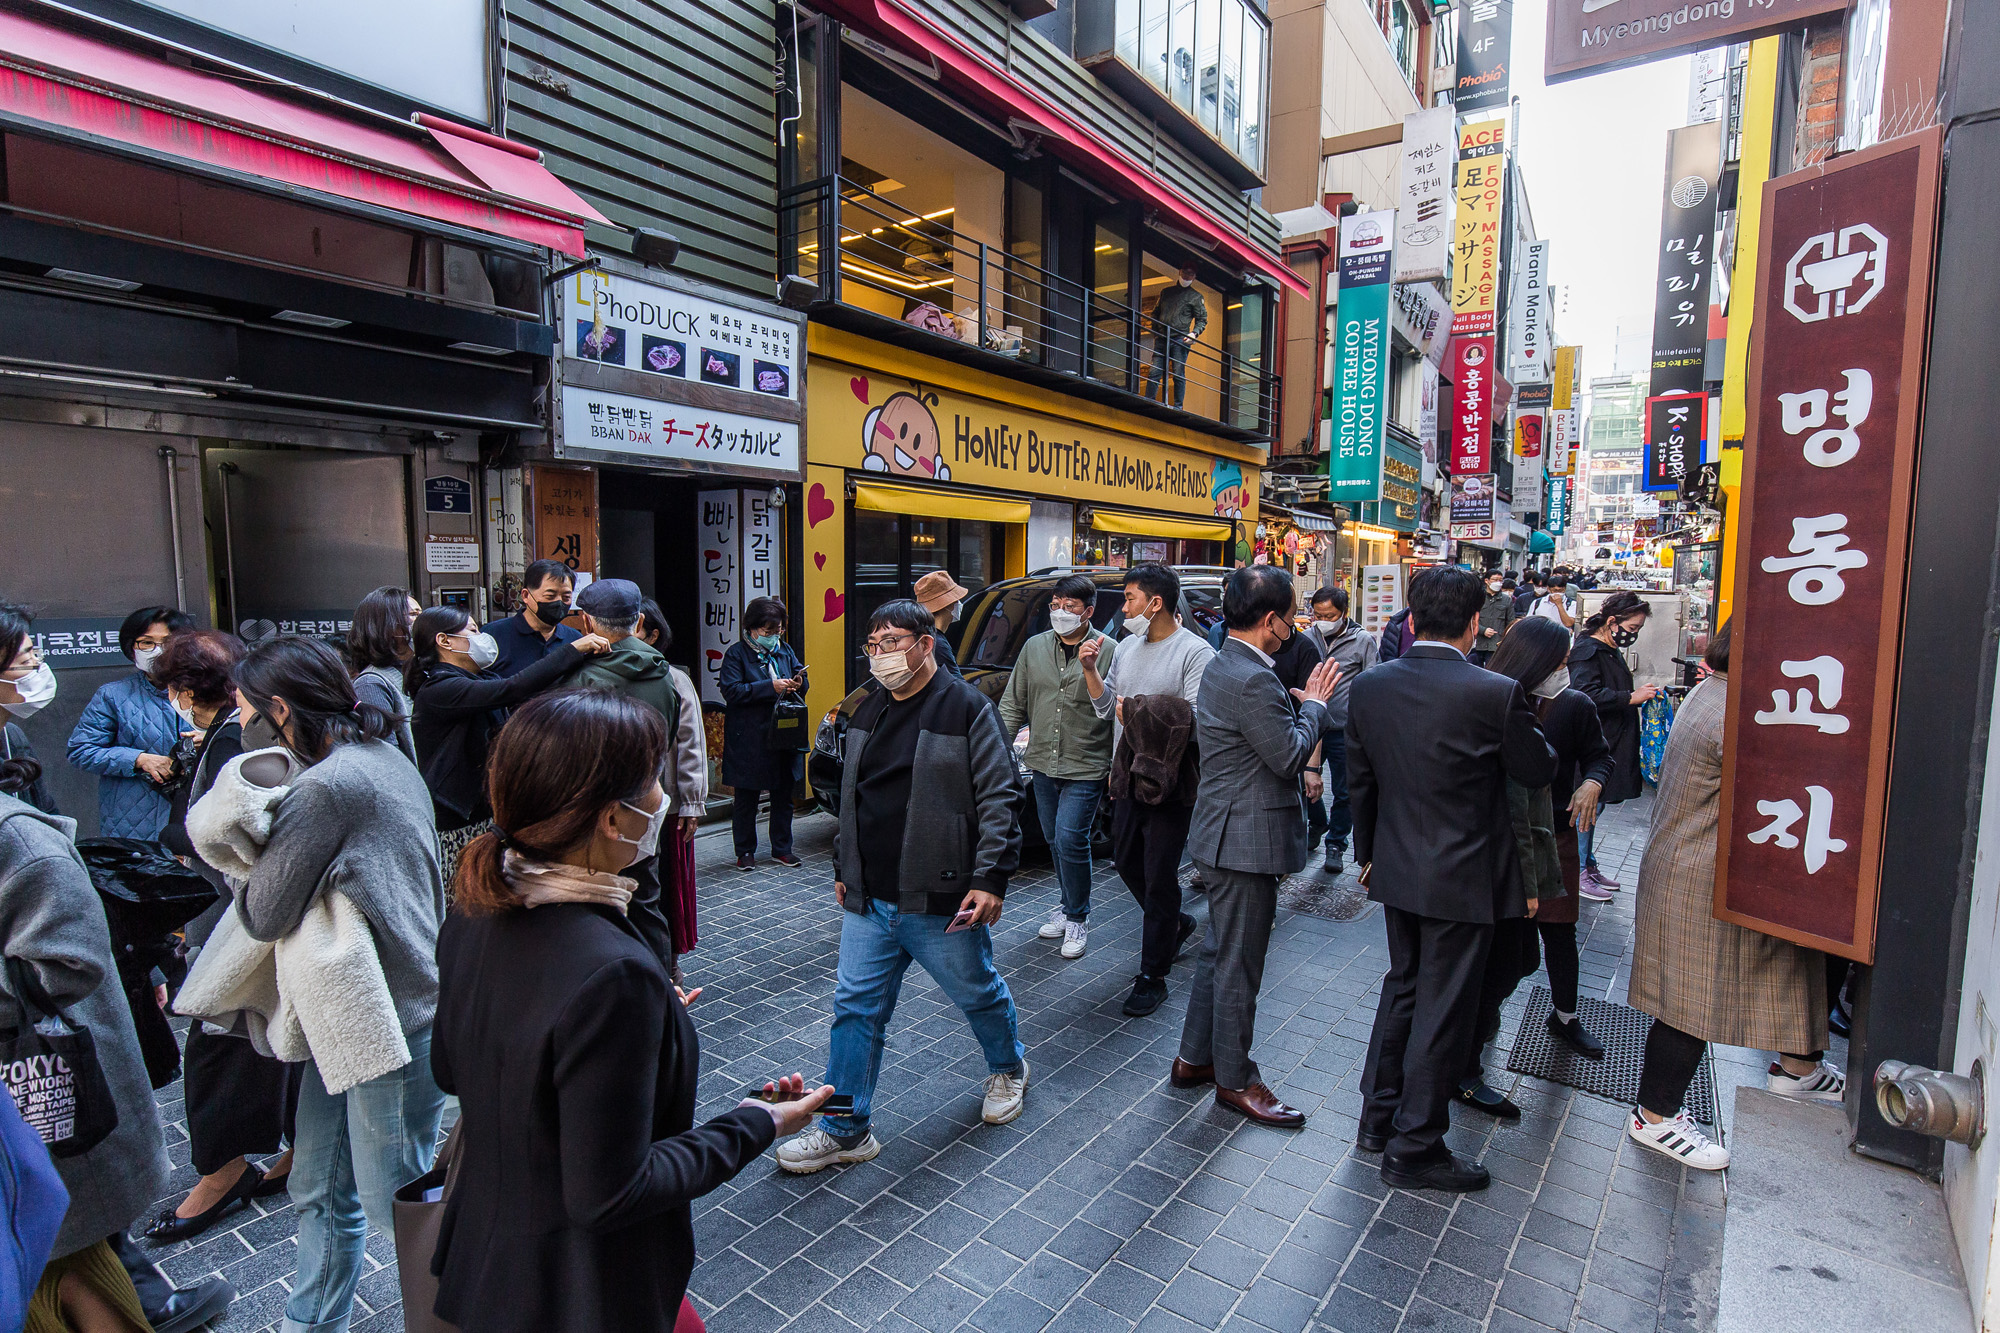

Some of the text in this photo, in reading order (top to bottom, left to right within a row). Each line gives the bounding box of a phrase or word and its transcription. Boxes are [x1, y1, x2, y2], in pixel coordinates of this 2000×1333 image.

[1581, 0, 1735, 47] Myeongdong
[1472, 36, 1495, 54] 4F
[1458, 69, 1503, 88] Phobia
[1455, 86, 1508, 102] www.xphobia.net
[1461, 128, 1503, 148] ACE
[1408, 142, 1444, 160] 제임스
[1467, 145, 1495, 157] 에이스
[1414, 162, 1436, 176] 치즈
[1408, 177, 1441, 197] 등갈비
[1456, 167, 1484, 307] 足マッサージ
[1478, 165, 1499, 306] FOOT MASSAGE
[1665, 233, 1706, 328] 밀피유
[1524, 244, 1543, 347] Brand Market
[597, 291, 701, 338] PhoDUCK
[1453, 313, 1492, 323] Full Body
[710, 312, 790, 345] 베요타 프리미엄
[1452, 322, 1491, 331] Massage
[710, 329, 790, 359] 이베리코 전문점
[1655, 347, 1702, 357] Millefeuille
[1340, 320, 1361, 458] COFFEE HOUSE
[1358, 318, 1379, 457] MYEONG DONG
[1519, 389, 1547, 398] Phobia
[587, 402, 653, 429] 빤닭빤닭
[1460, 369, 1484, 454] 홍콩반점
[1667, 406, 1690, 424] K
[591, 426, 652, 445] BBAN DAK
[662, 418, 782, 457] チーズタッカルビ
[1554, 414, 1566, 469] REDEYE
[1028, 429, 1091, 482] BUTTER
[1155, 470, 1164, 492] &
[1164, 460, 1208, 499] FRIENDS
[444, 494, 454, 509] 5
[552, 488, 582, 501] 고기가
[543, 503, 590, 518] 맛있는 집
[497, 528, 523, 544] Duck
[1465, 525, 1476, 537] 元
[552, 533, 581, 571] 생
[751, 498, 773, 597] 닭갈비
[1747, 368, 1874, 875] 명동교자
[51, 646, 89, 656] ELECTRIC
[28, 1085, 75, 1105] MOSCOW
[46, 1096, 76, 1110] TAIPEI
[45, 1105, 76, 1118] JAKARTA
